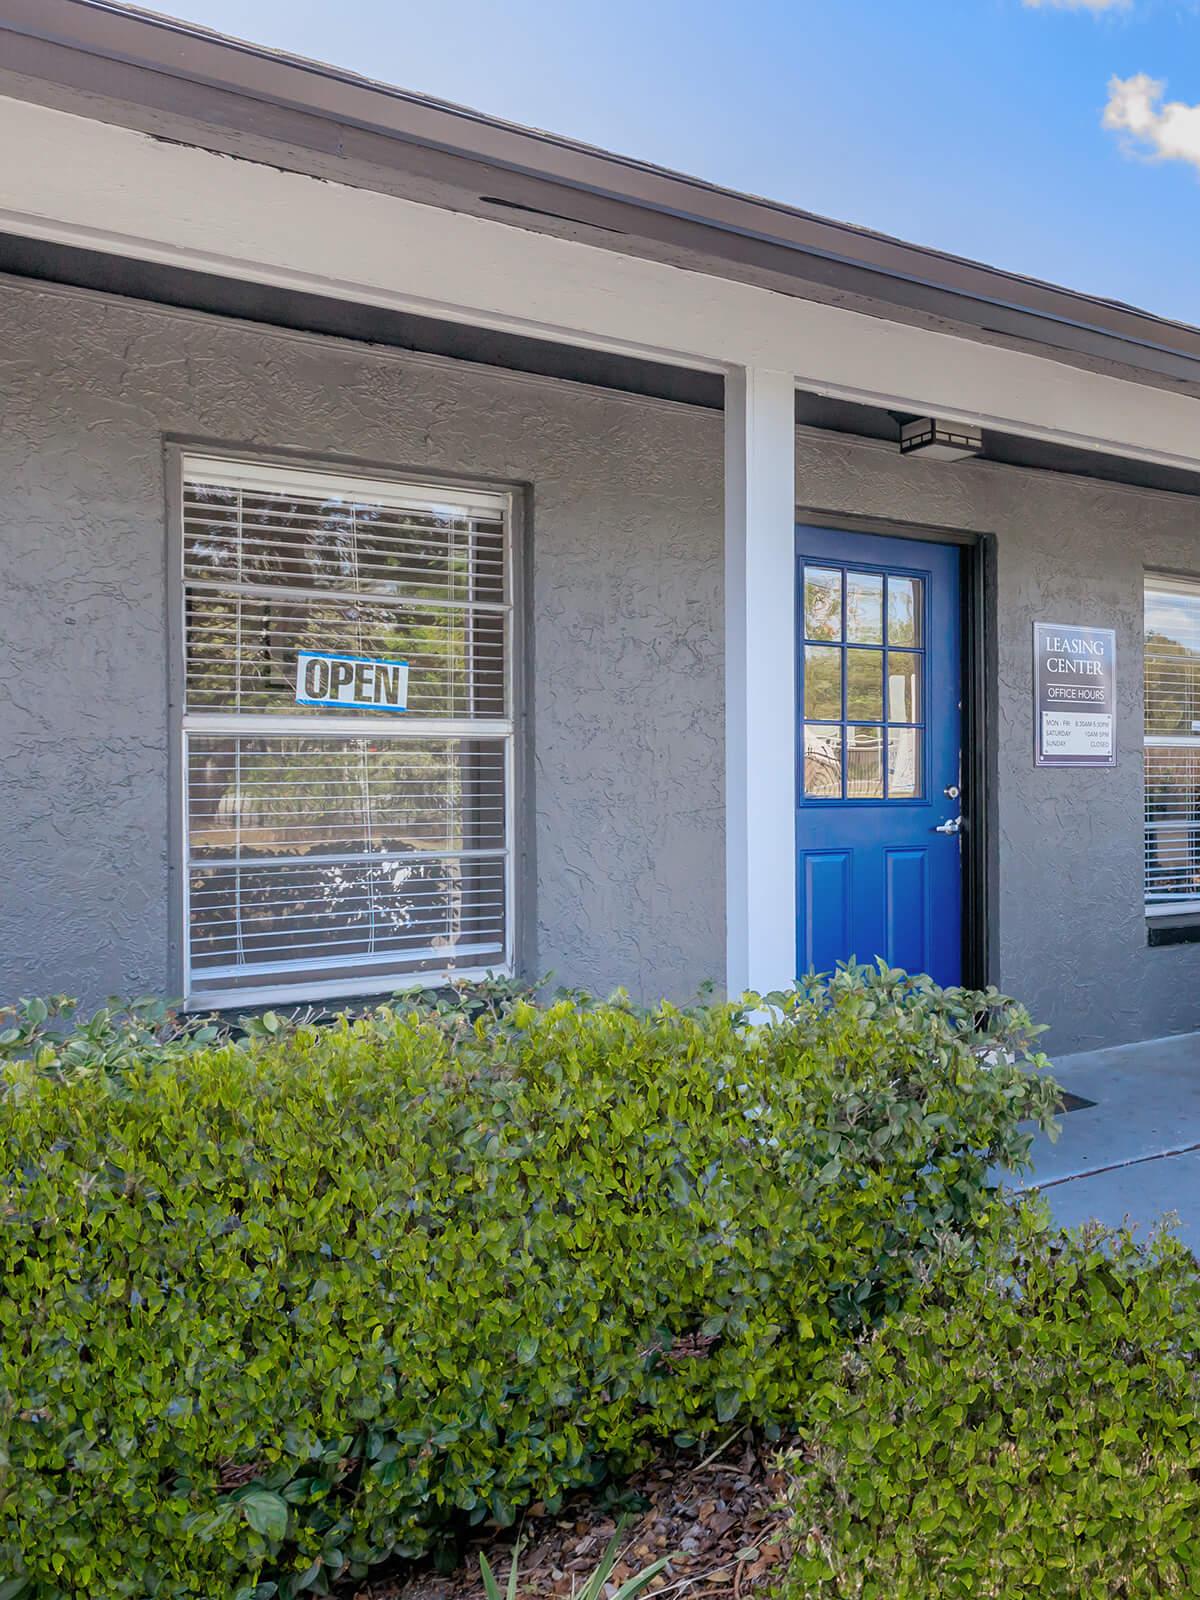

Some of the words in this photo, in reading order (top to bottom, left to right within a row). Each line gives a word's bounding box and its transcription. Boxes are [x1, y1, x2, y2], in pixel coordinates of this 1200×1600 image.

[1046, 637, 1104, 655] LEASING
[1046, 657, 1104, 675] CENTER
[304, 659, 400, 705] OPEN
[1048, 687, 1077, 699] OFFICE
[1078, 689, 1105, 701] HOURS
